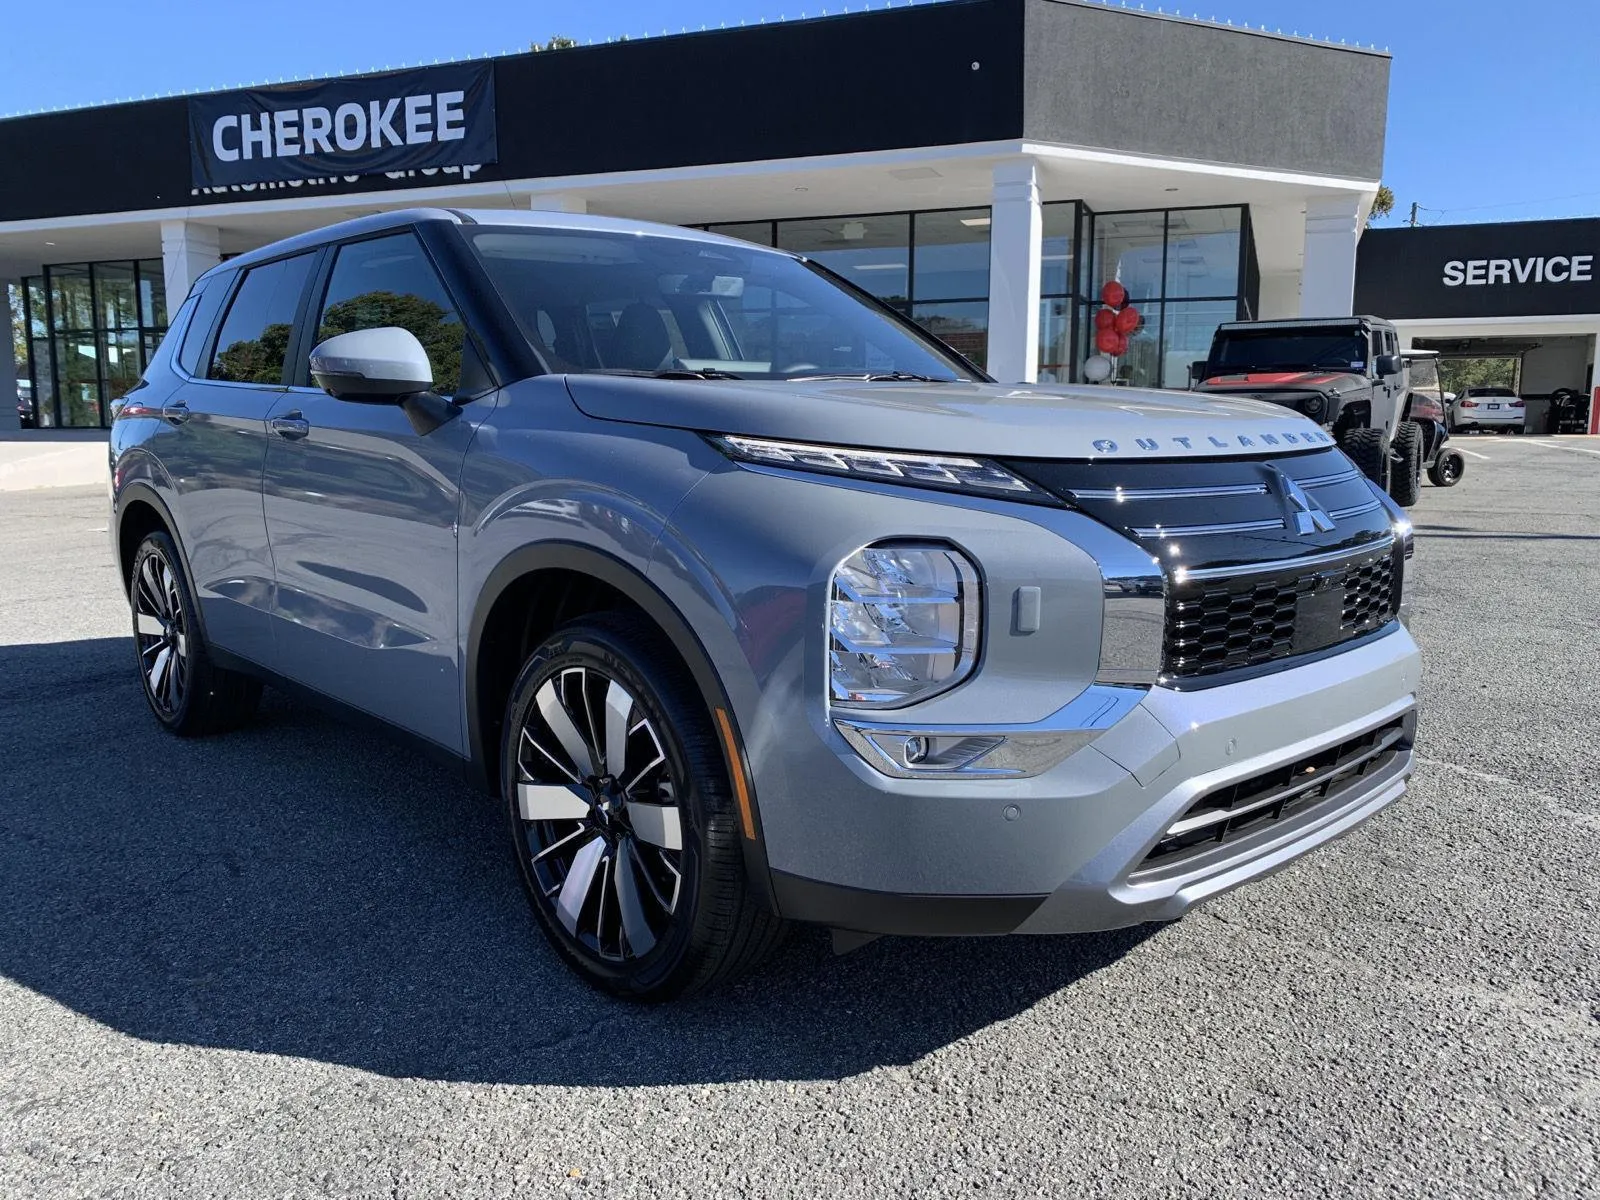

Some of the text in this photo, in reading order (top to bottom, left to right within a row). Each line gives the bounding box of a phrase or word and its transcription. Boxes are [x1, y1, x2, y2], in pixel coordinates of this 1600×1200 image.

[212, 90, 466, 162] CHEROKEE
[1442, 255, 1593, 286] SERVICE
[1092, 431, 1329, 453] OUTLANDER
